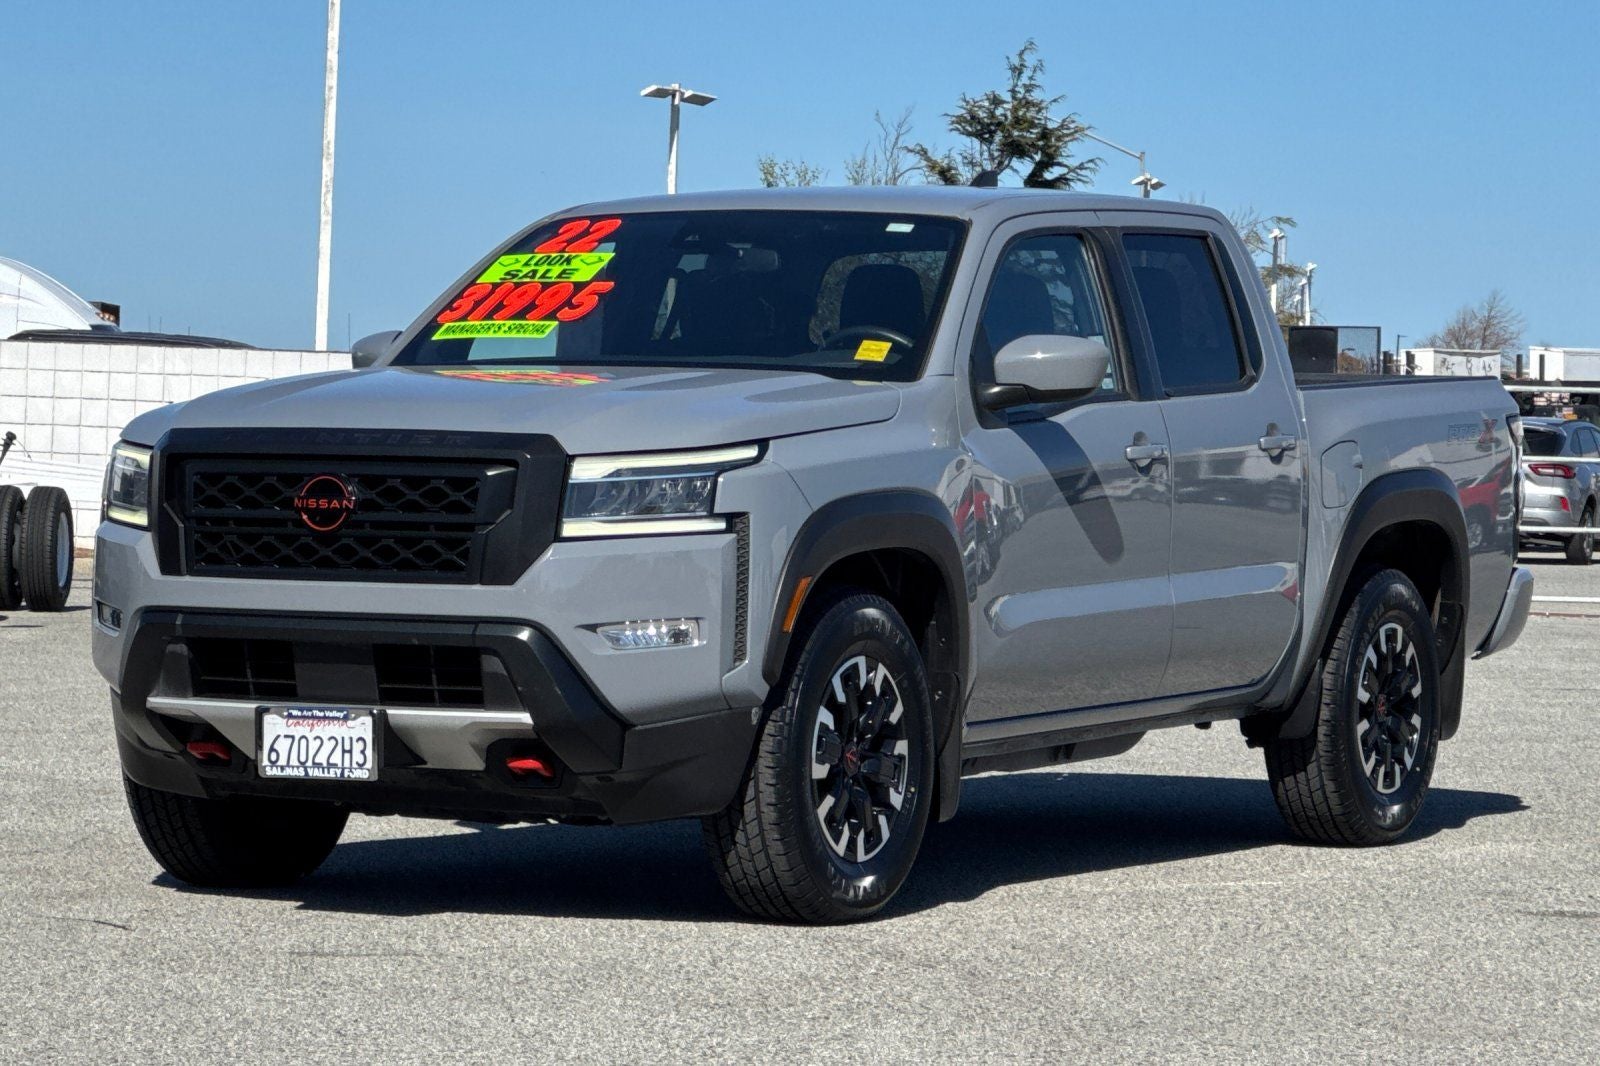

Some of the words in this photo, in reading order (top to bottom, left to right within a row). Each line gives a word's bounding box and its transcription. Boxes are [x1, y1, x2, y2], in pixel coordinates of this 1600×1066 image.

[534, 218, 622, 253] 22
[521, 254, 579, 267] LOOK
[499, 267, 579, 281] SALE
[436, 281, 615, 324] 31995
[504, 322, 551, 335] SPECIAL
[294, 497, 355, 510] NISSAN
[312, 709, 325, 717] The
[285, 718, 356, 733] California
[267, 733, 368, 768] 67022H3
[265, 766, 306, 777] SALINAS
[306, 767, 342, 778] VALLEY
[343, 768, 370, 779] FORD
